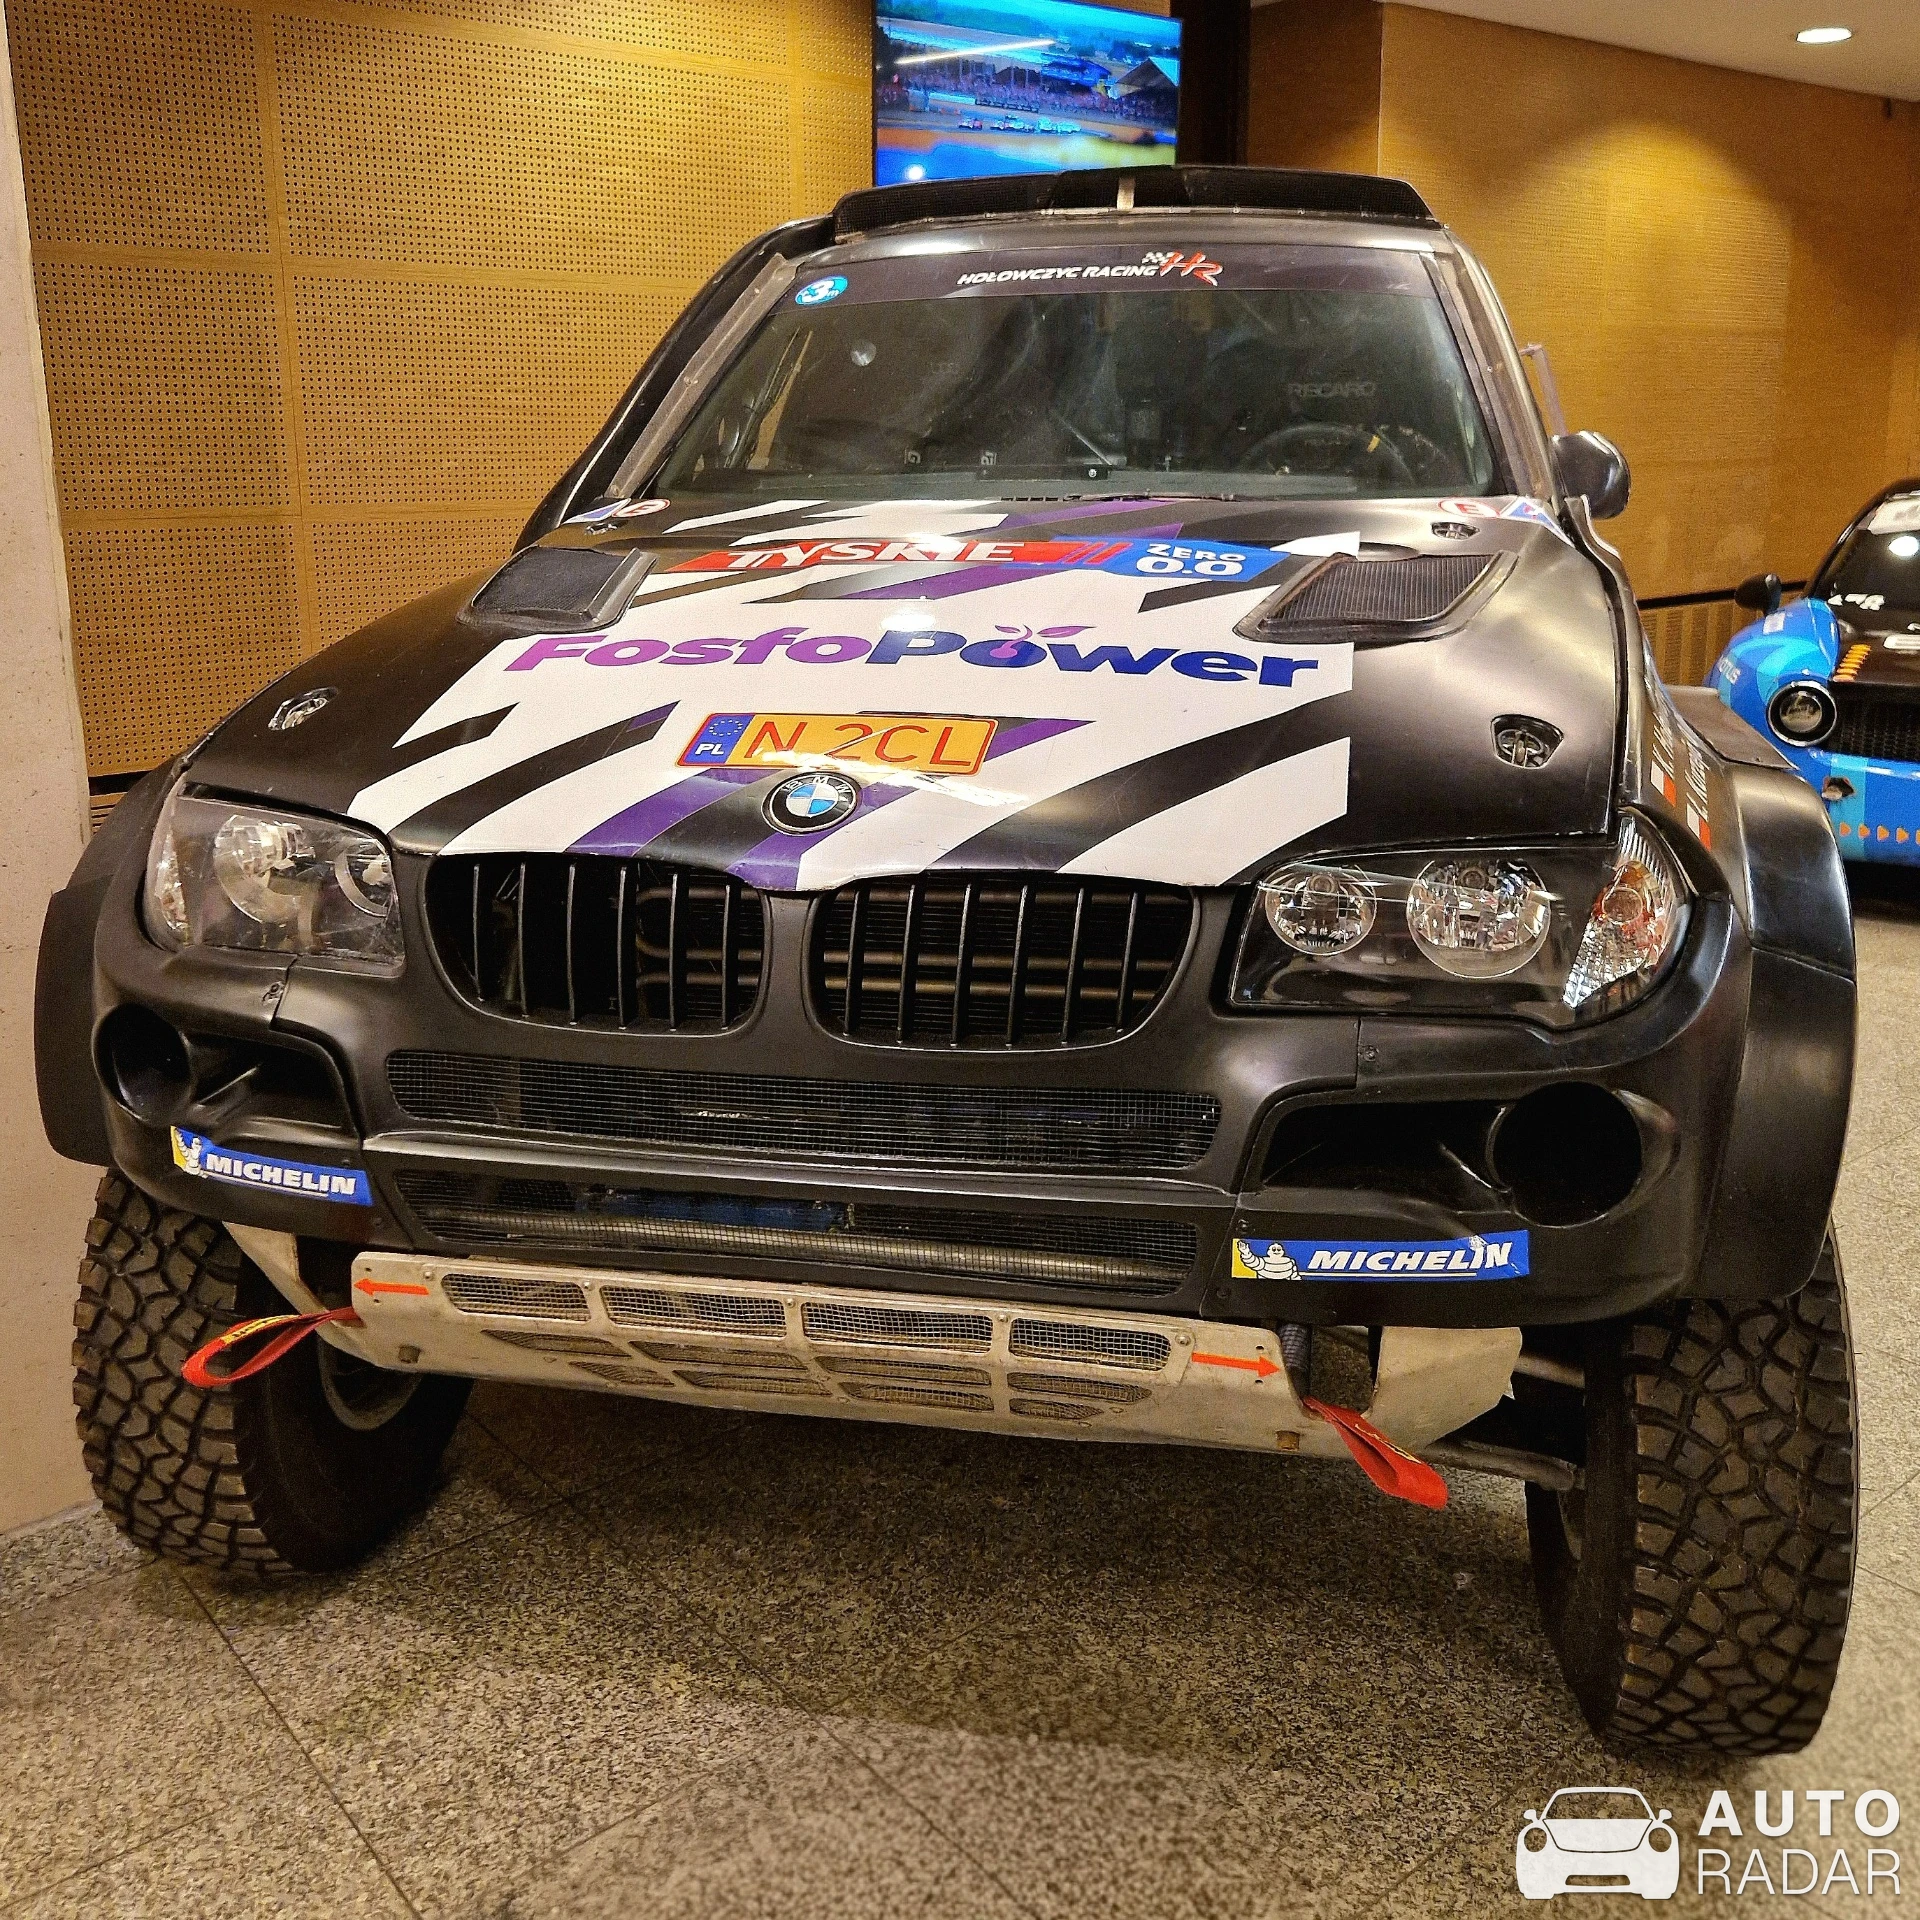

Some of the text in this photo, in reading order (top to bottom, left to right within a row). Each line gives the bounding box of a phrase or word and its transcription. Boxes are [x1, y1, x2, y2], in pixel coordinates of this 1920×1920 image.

[957, 264, 1159, 285] HOŁOWCZYC RACING
[1288, 382, 1377, 397] RECARO
[1454, 503, 1486, 515] E
[727, 541, 1026, 569] TYSKIE
[1145, 543, 1247, 563] ZERO
[503, 626, 1319, 688] FosfoPower
[695, 743, 725, 756] PL
[743, 721, 973, 767] N 2CL
[206, 1153, 357, 1195] MICHELIN
[1308, 1242, 1513, 1270] MICHELIN
